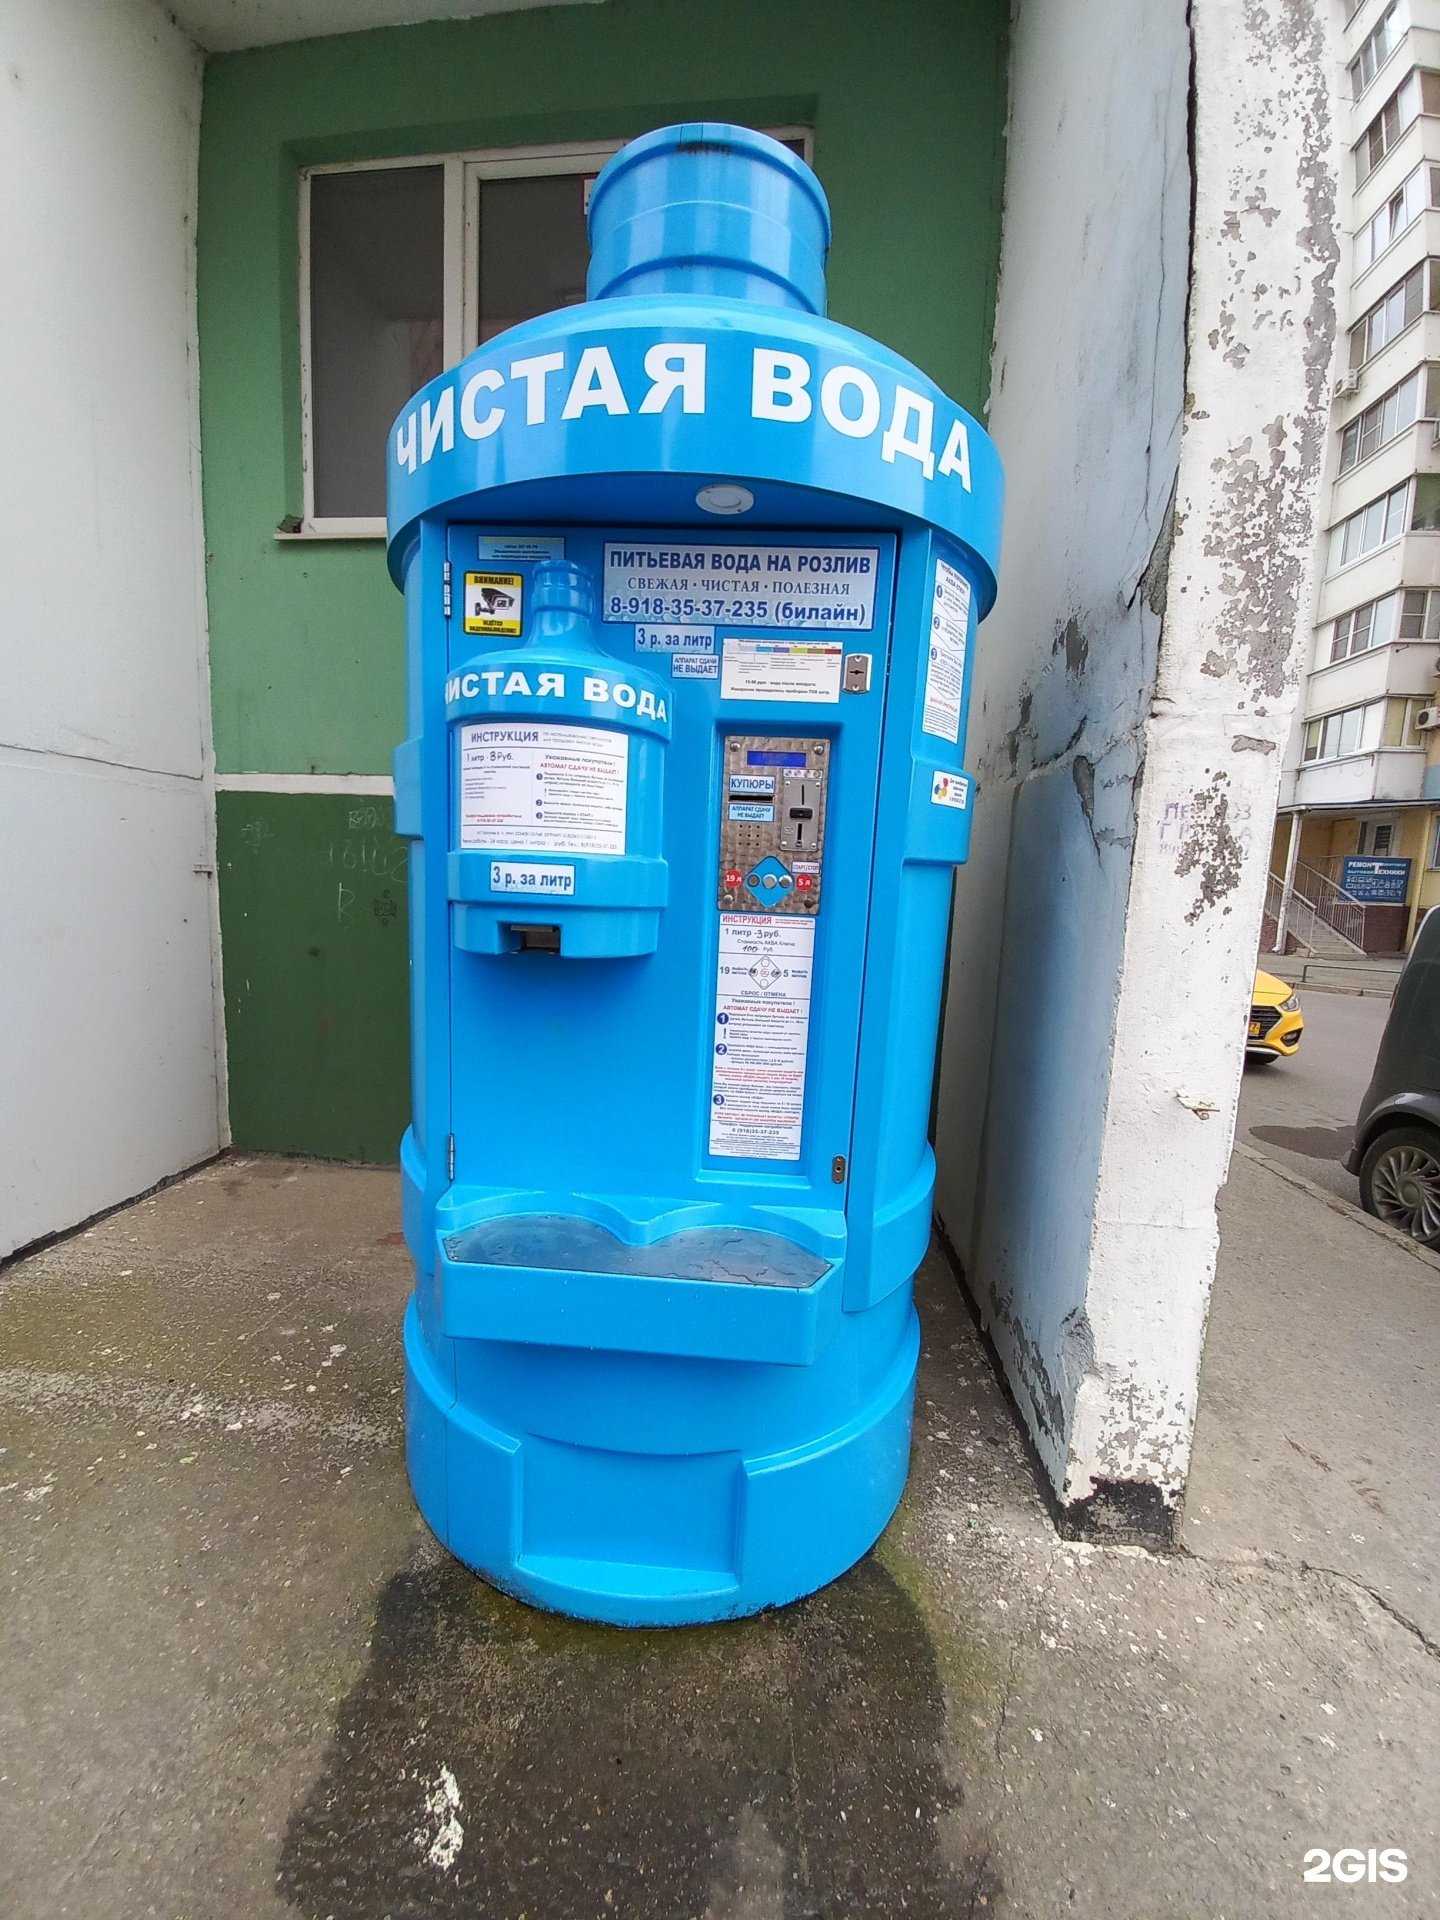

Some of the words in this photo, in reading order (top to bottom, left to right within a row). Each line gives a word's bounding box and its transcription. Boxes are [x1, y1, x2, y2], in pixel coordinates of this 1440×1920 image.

[396, 343, 706, 475] ЧИСТАЯ
[751, 347, 972, 493] ВОДА
[610, 551, 705, 570] ПИТЬЕВАЯ
[711, 554, 761, 574] ВОДА
[767, 555, 791, 572] НА
[797, 555, 871, 574] РОЗЛИВ
[627, 577, 689, 591] СВЕЖАЯ
[701, 579, 760, 593] ЧИСТАЯ
[772, 581, 850, 596] ПОЛЕЗНАЯ
[610, 597, 768, 619] 8-918-35-37-235
[774, 601, 866, 624] (билайн)
[637, 628, 646, 645] 3
[650, 633, 661, 649] р.
[665, 634, 680, 647] за
[683, 634, 712, 650] литр
[673, 664, 684, 673] НЕ
[685, 665, 718, 675] ВЫДАЕТ
[584, 676, 667, 723] ВОДА
[471, 730, 539, 743] ИНСТРУКЦИЯ
[731, 778, 774, 790] КУПЮРЫ
[493, 866, 501, 883] 3
[505, 876, 516, 887] р.
[520, 874, 536, 885] за
[540, 875, 572, 890] литр
[798, 878, 803, 886] 5
[722, 915, 772, 925] ИНСТРУКЦИЯ
[731, 928, 752, 937] литр
[720, 966, 730, 975] 19
[783, 969, 789, 977] 5
